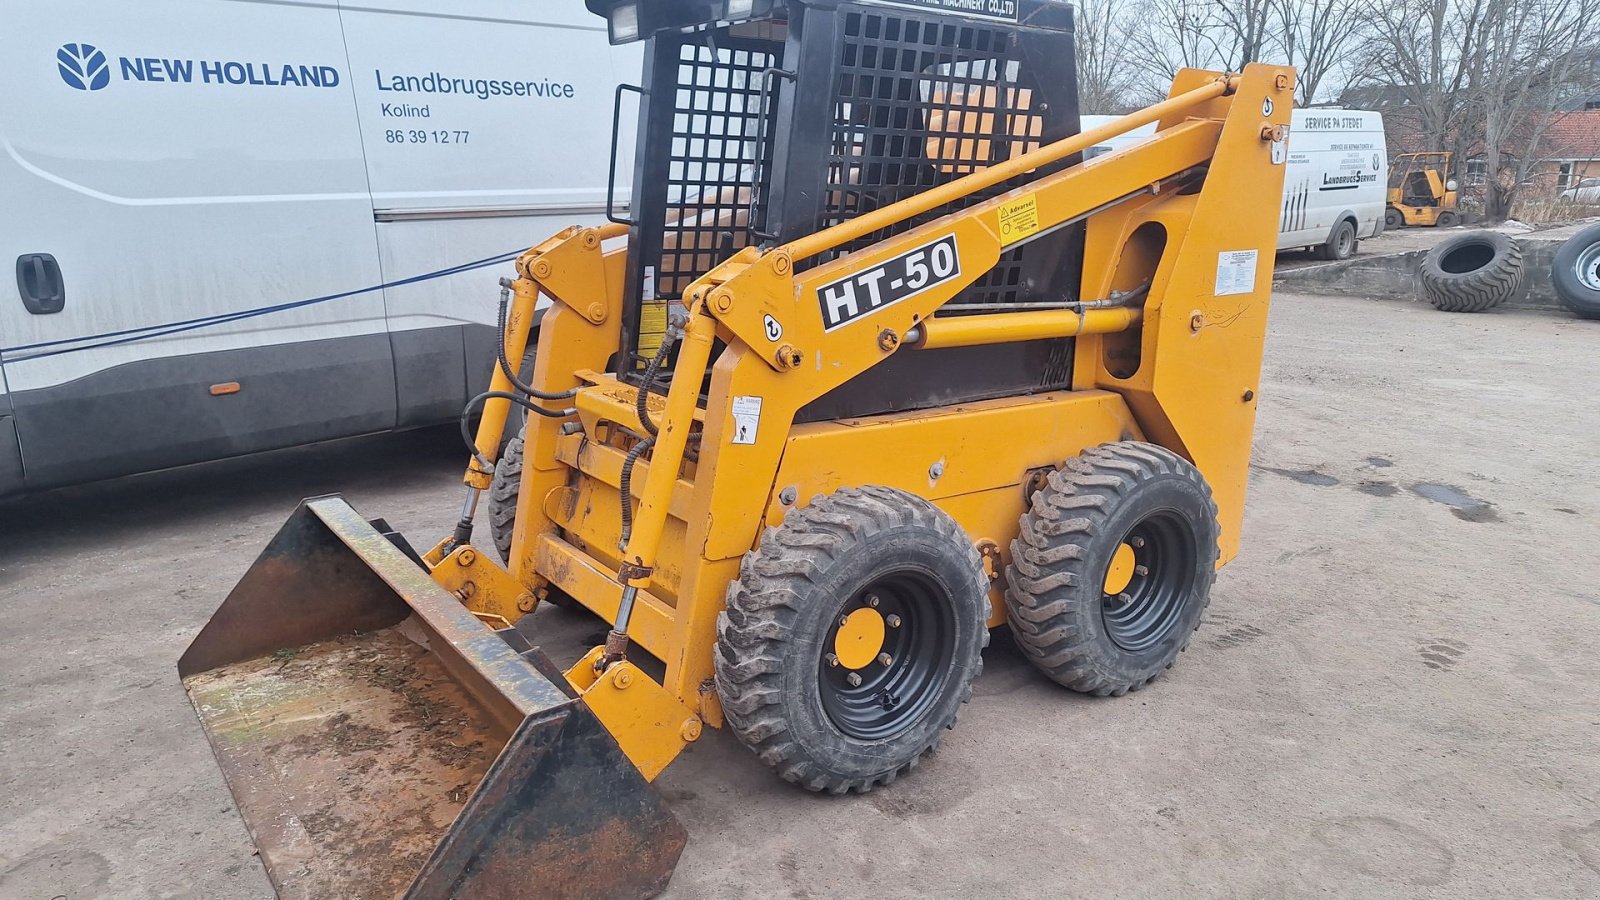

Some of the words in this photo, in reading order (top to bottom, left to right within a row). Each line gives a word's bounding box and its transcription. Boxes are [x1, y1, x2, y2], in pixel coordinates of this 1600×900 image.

[119, 57, 193, 83] NEW
[200, 60, 340, 88] HOLLAND
[375, 69, 574, 100] Landbrugsservice
[381, 103, 430, 118] Kolind
[1305, 117, 1331, 129] SERVICE
[1342, 117, 1363, 129] STEDET
[385, 129, 404, 144] 86
[409, 130, 427, 144] 39
[432, 130, 449, 144] 12
[453, 130, 470, 144] 77
[825, 242, 954, 324] HT-50
